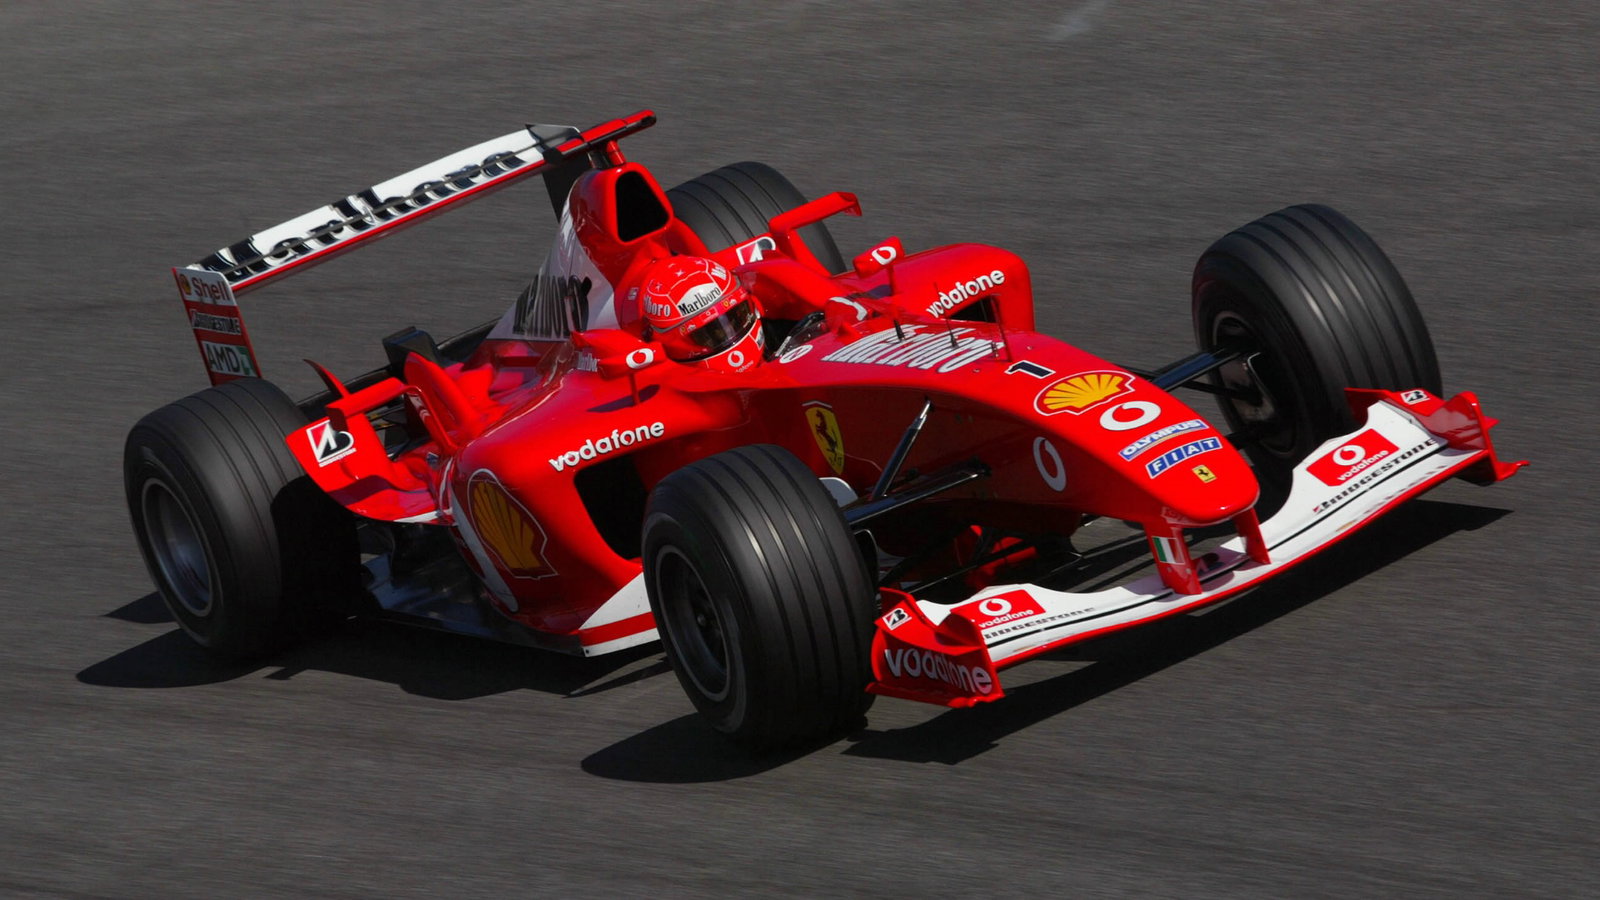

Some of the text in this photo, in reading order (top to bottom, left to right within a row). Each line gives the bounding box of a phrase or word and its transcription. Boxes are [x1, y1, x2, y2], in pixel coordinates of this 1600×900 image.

[191, 276, 231, 301] Shell
[678, 285, 722, 317] Marlboro
[925, 269, 1005, 319] vodafone
[205, 343, 241, 374] AMD
[548, 421, 665, 472] vodafone
[1122, 419, 1202, 457] OLYMPUS
[1151, 439, 1216, 473] FIAT
[1336, 449, 1390, 482] vodafone
[1312, 438, 1437, 514] BRIDGESTONE
[978, 609, 1034, 628] vodafone
[884, 647, 992, 694] vodafone
